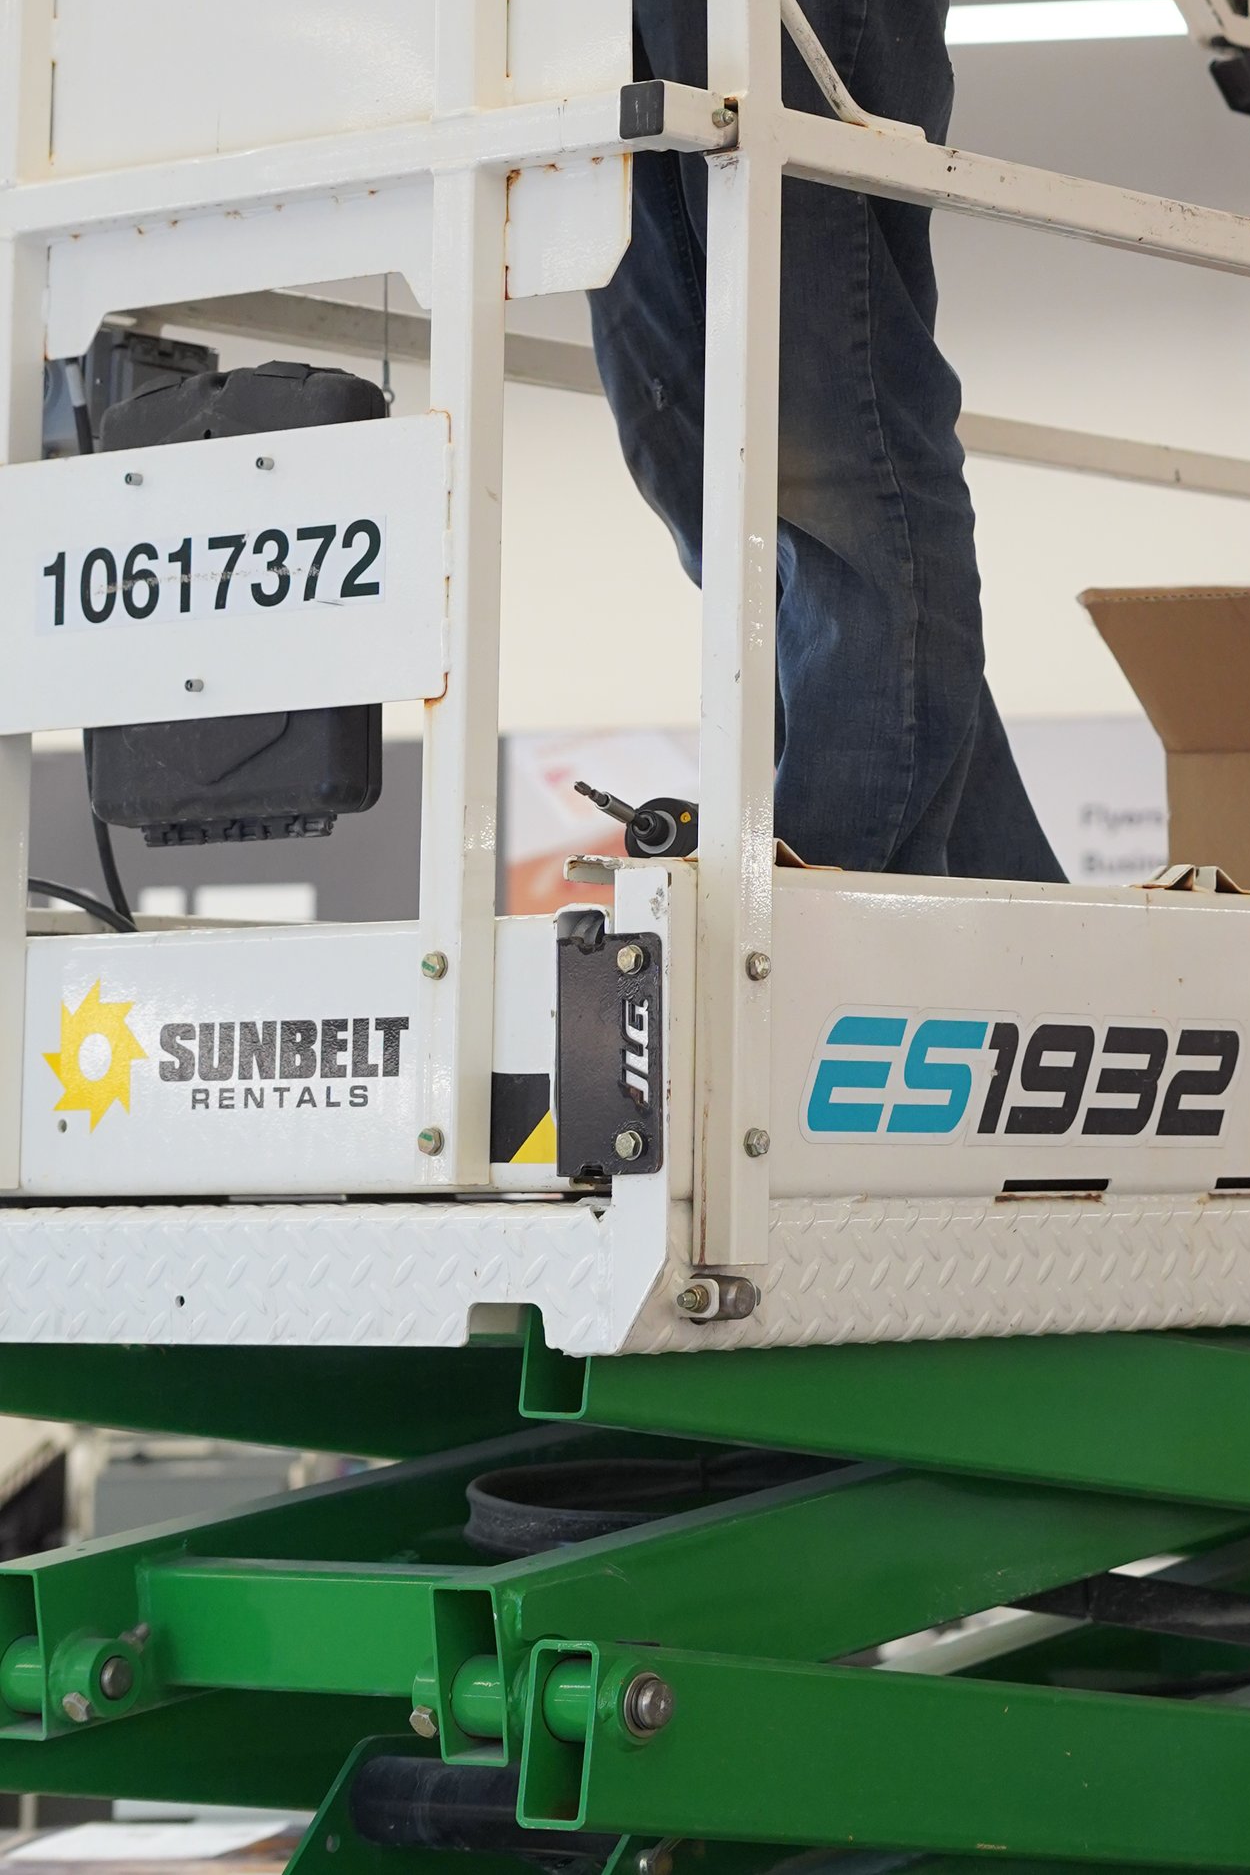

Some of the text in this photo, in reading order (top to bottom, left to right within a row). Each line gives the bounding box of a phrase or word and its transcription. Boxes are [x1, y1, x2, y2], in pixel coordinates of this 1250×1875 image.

[43, 518, 382, 627] 10617372
[159, 1016, 409, 1082] SUNBELT
[191, 1085, 369, 1110] RENTALS
[621, 997, 649, 1109] JLG
[806, 1015, 1240, 1136] ES1932
